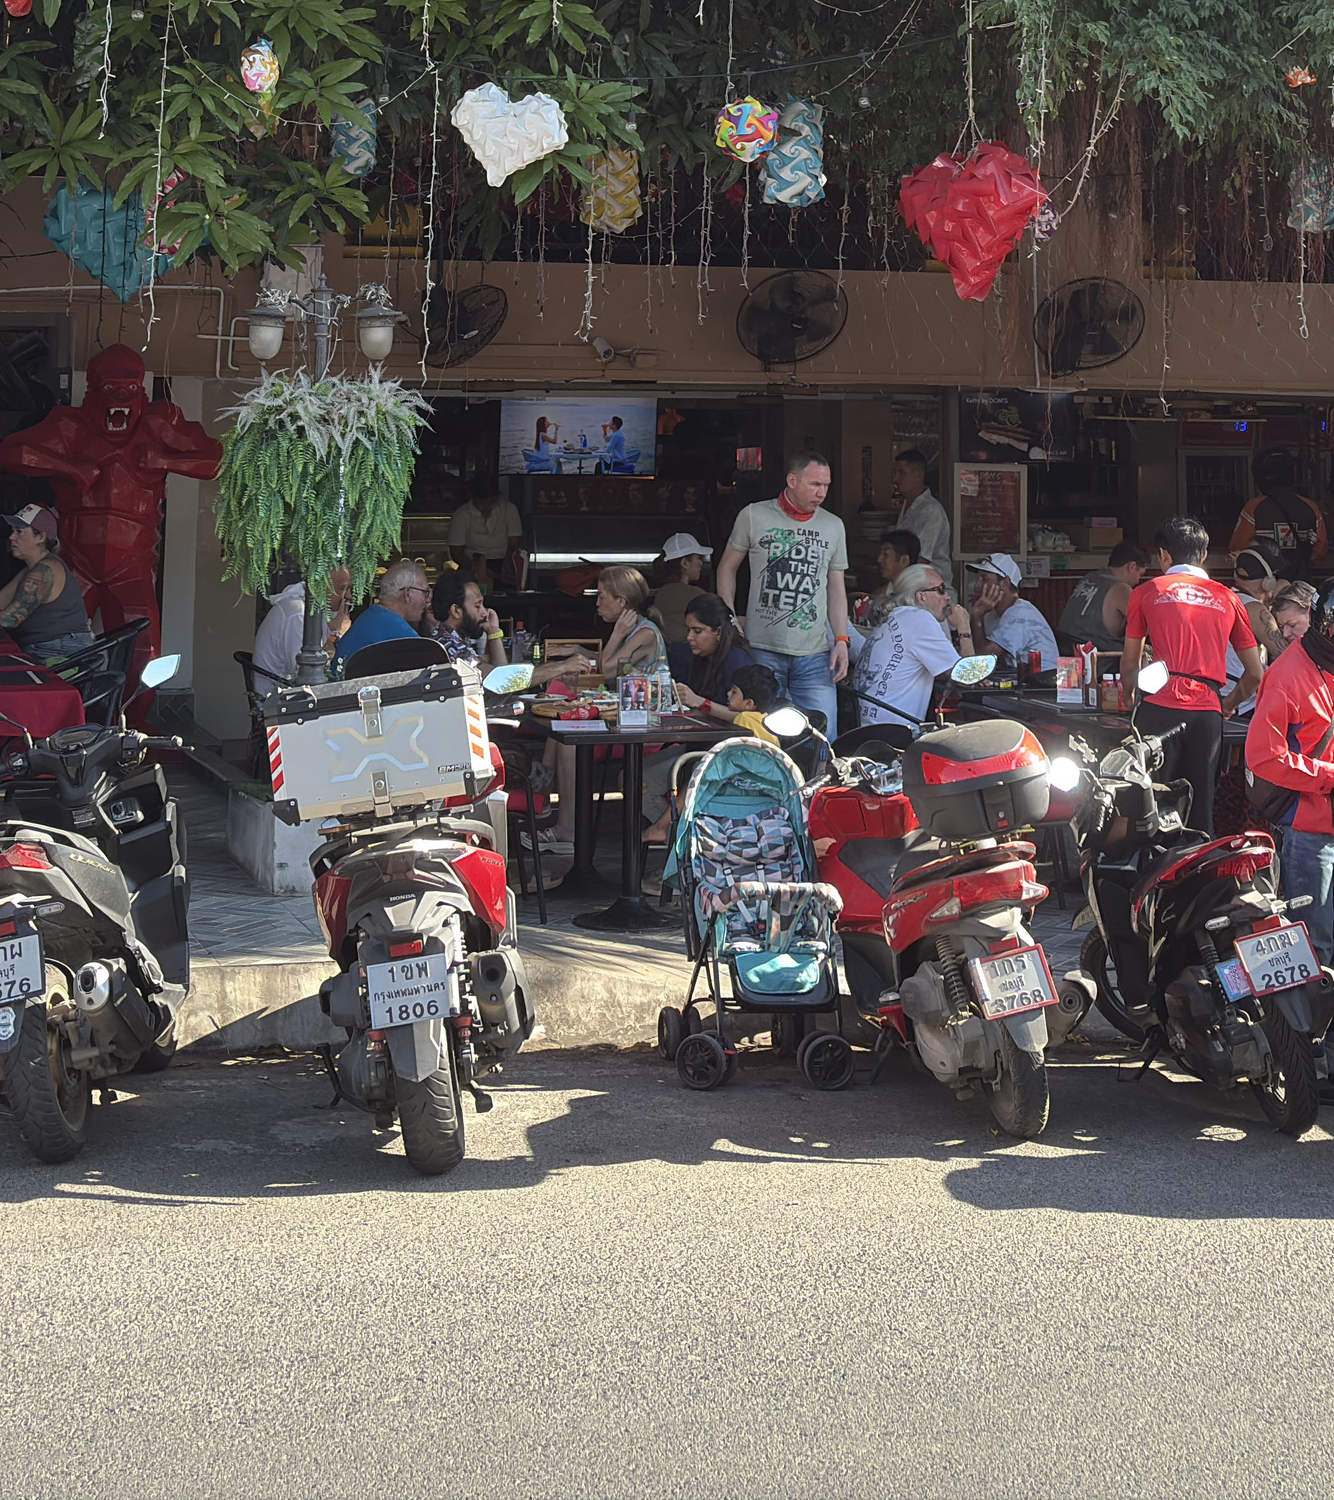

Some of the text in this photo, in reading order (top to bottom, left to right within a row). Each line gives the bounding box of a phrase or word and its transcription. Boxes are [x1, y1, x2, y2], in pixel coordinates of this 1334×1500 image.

[797, 528, 819, 537] CAMP
[769, 542, 819, 560] RIDE
[805, 537, 829, 549] STYLE
[789, 561, 817, 576] THE
[776, 571, 814, 593] WA
[389, 893, 416, 901] HONDA
[1268, 952, 1291, 967] ชลบุรี
[1261, 964, 1311, 990] 2678
[374, 981, 446, 1004] กรุงเทพมหานคร
[386, 1000, 439, 1023] 1806
